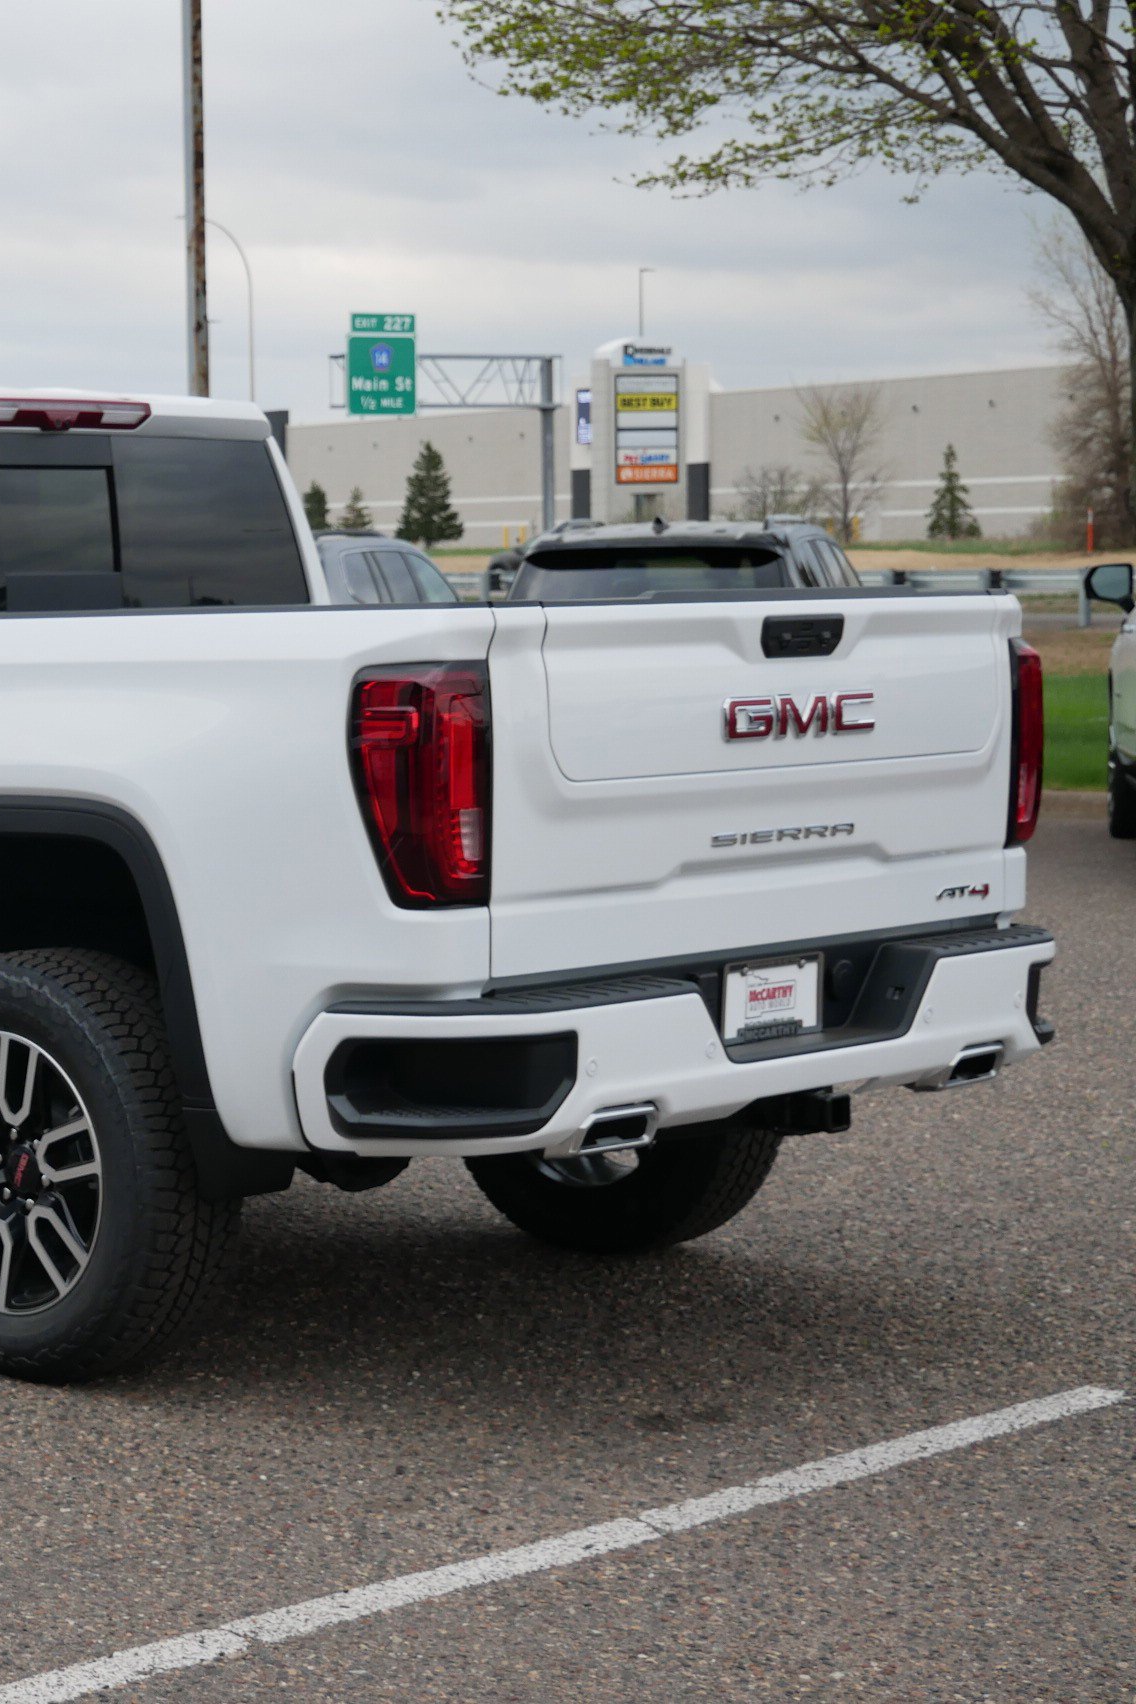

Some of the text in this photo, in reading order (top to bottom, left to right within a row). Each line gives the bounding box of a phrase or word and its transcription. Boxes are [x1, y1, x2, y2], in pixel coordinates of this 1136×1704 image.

[354, 316, 412, 331] EXIT 227
[374, 350, 389, 366] 14
[351, 376, 413, 391] Main St
[380, 397, 404, 408] MILE
[621, 397, 672, 407] BEST BUY
[633, 468, 674, 481] SIERRA
[722, 689, 876, 742] GMC
[710, 822, 855, 848] SIERRA
[935, 882, 991, 902] AT4
[749, 985, 793, 1002] McCARTHY
[13, 1152, 30, 1188] GMC
